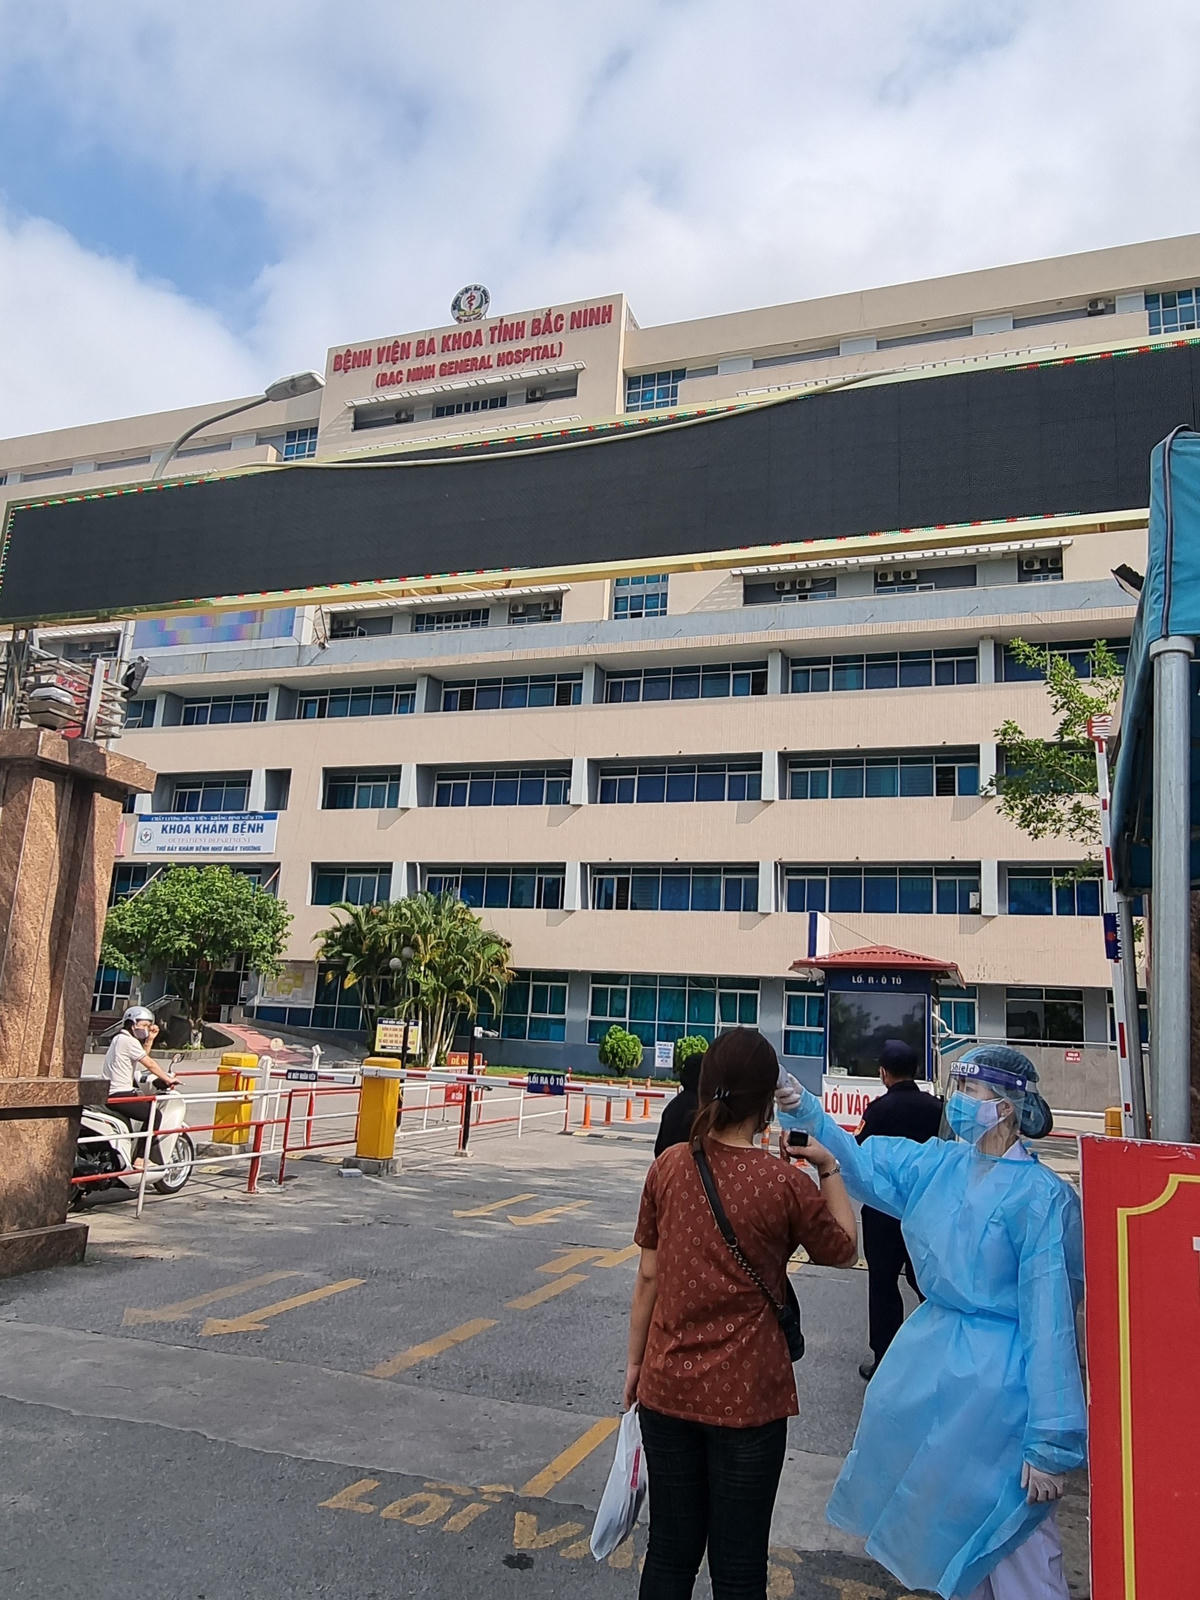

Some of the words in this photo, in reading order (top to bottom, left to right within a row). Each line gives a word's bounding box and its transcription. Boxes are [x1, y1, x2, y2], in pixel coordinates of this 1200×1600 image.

[333, 348, 372, 373] BỆNH
[377, 340, 411, 365] VIỆN
[416, 337, 436, 357] ĐA
[440, 329, 483, 353] KHOA
[489, 318, 526, 344] TỈNH
[531, 308, 564, 336] BẮC
[570, 304, 613, 330] NINH
[376, 369, 403, 388] (BAC
[406, 364, 435, 382] NINH
[439, 354, 493, 376] GENERAL
[496, 341, 563, 367] HOSPITAL)
[161, 823, 191, 834] KHOA
[194, 820, 229, 834] KHÁM
[232, 820, 264, 836] BỆNH
[539, 1076, 548, 1085] RA
[824, 1084, 843, 1114] LỐI
